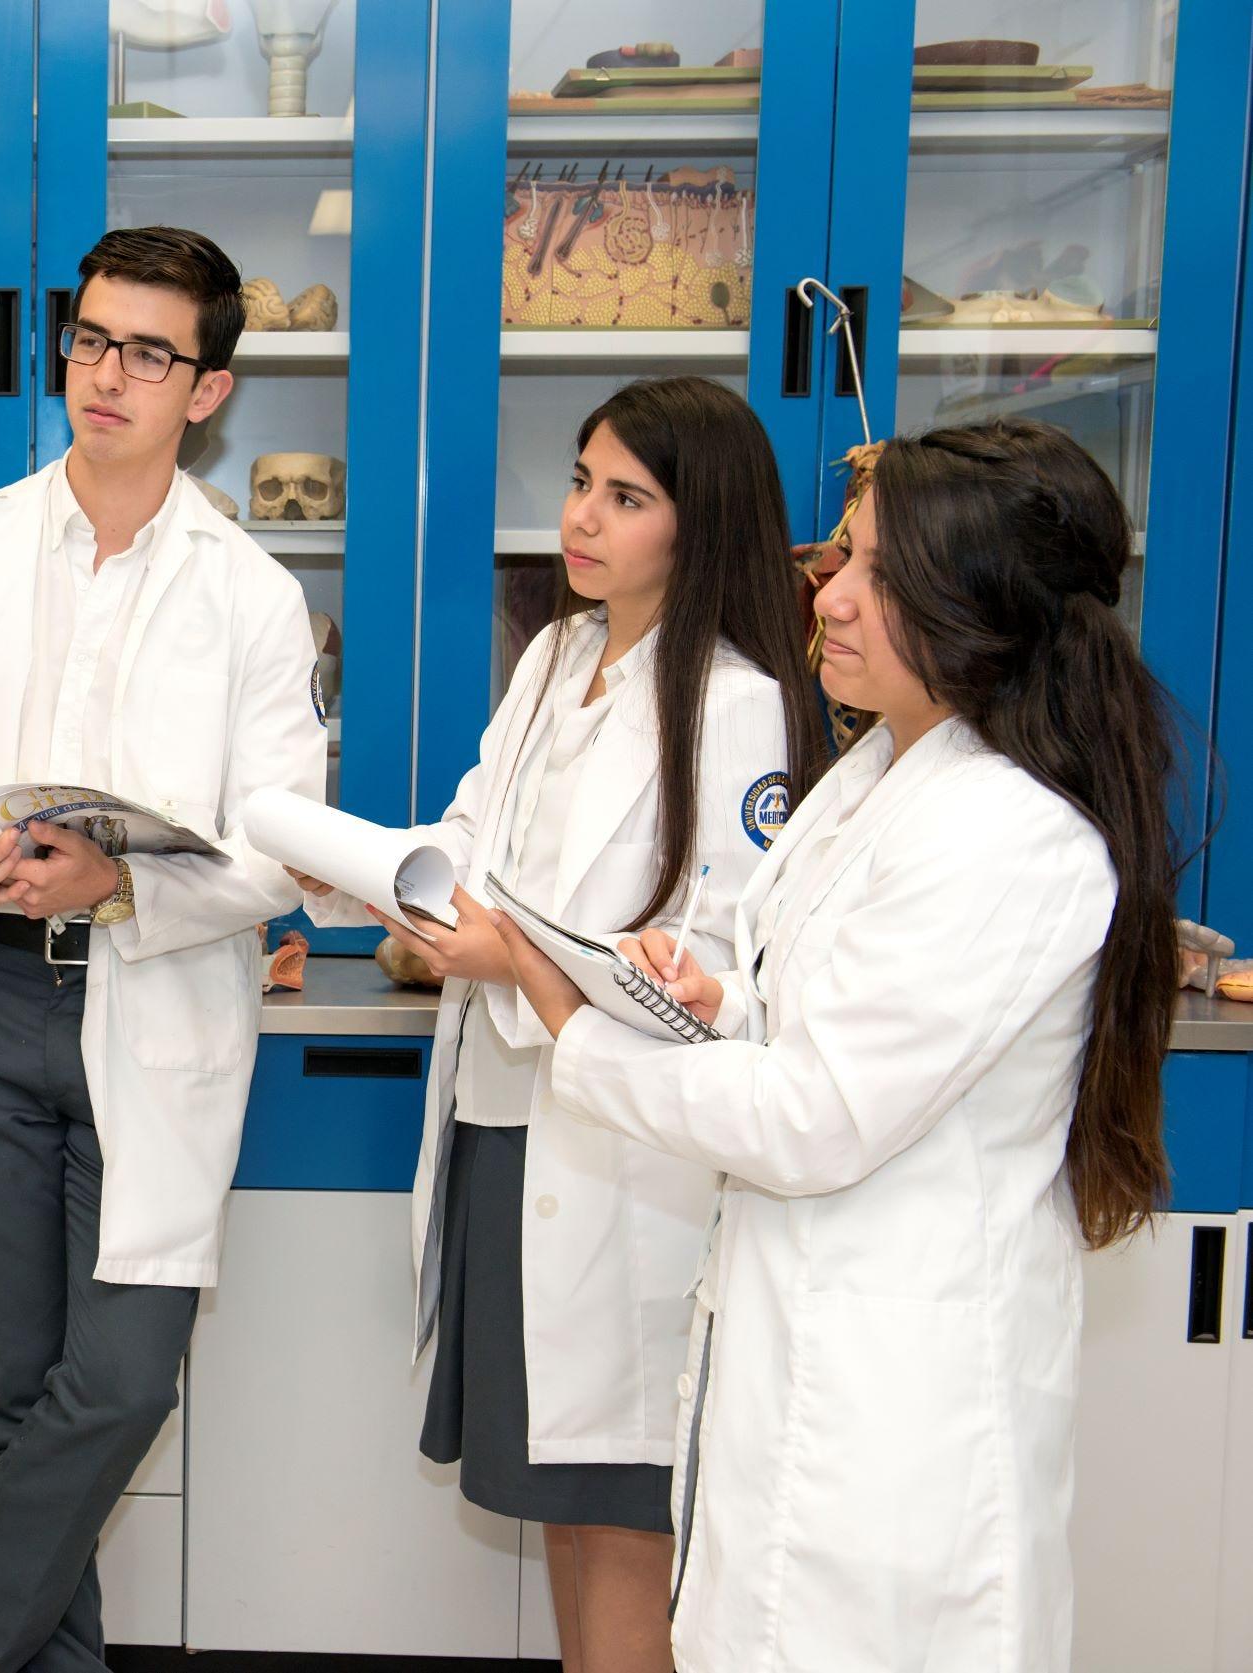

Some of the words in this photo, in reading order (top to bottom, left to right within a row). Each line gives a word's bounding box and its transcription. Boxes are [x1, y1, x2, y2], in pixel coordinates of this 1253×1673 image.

[18, 807, 60, 831] Mnual
[63, 803, 80, 812] de
[745, 779, 768, 831] UNIVERSIDAD
[768, 775, 776, 784] DE
